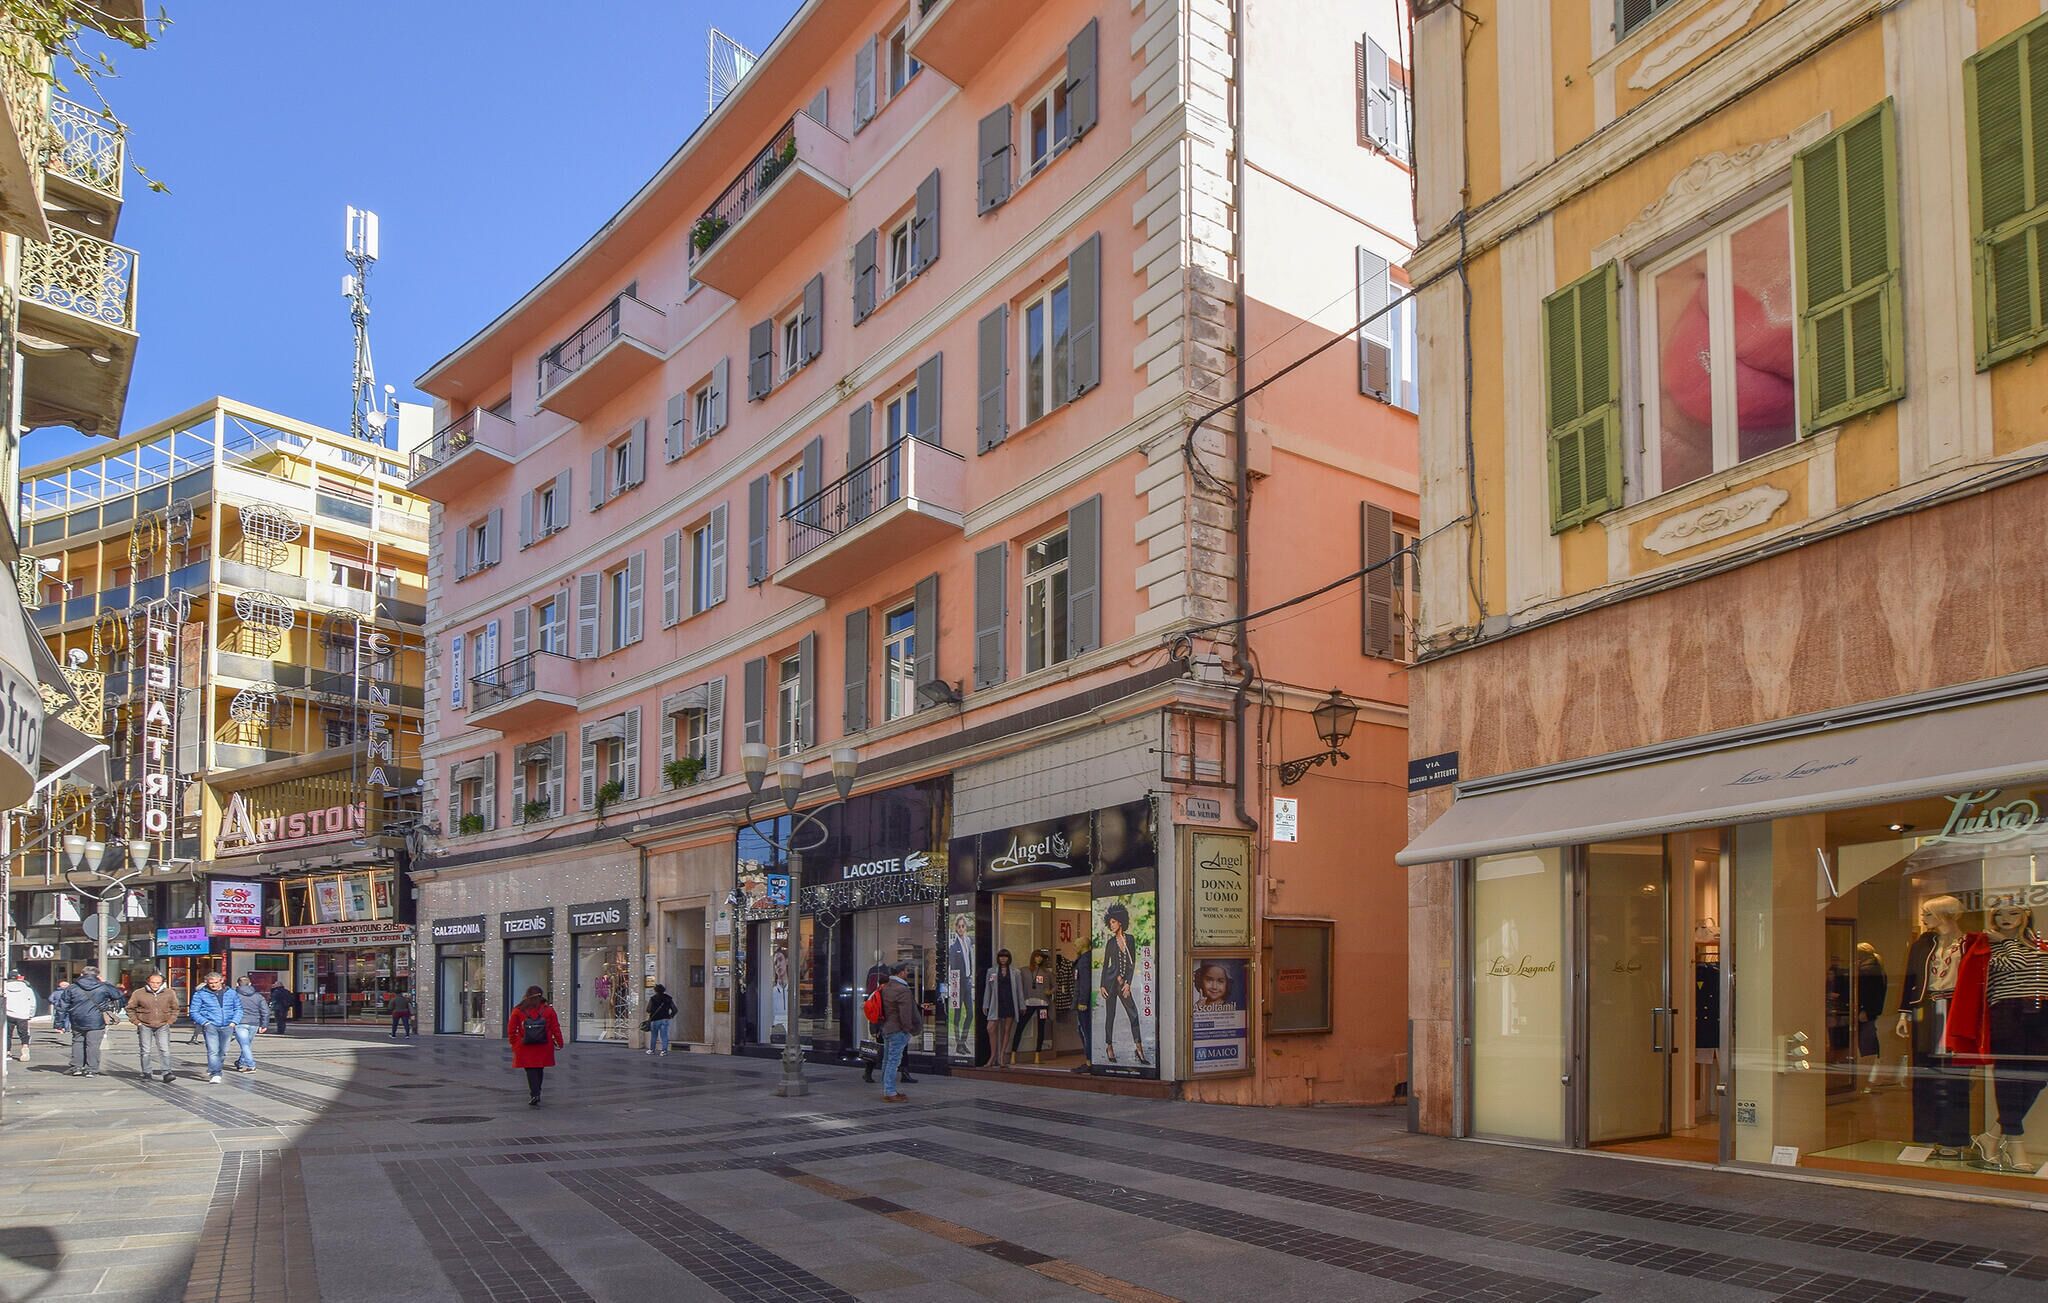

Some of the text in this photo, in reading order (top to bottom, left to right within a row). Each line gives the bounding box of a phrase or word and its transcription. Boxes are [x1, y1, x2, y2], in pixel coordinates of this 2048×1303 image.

[367, 633, 391, 787] CINEMA
[1425, 761, 1440, 769] VIA
[1196, 802, 1210, 810] VIA
[214, 792, 367, 846] ARISTON
[1922, 788, 2039, 846] Luisa
[991, 835, 1053, 872] Angel
[844, 858, 900, 879] LACOSTE
[1200, 850, 1242, 876] Angel
[1110, 877, 1136, 887] woman
[1201, 880, 1242, 890] DONNA
[1205, 892, 1239, 902] UOMO
[434, 923, 480, 936] CALZEDONIA
[30, 945, 54, 958] OVS
[1486, 955, 1556, 978] Luisa Spagnoli
[1193, 1002, 1237, 1012] Ascoltami!
[1208, 1048, 1237, 1057] MAICO
